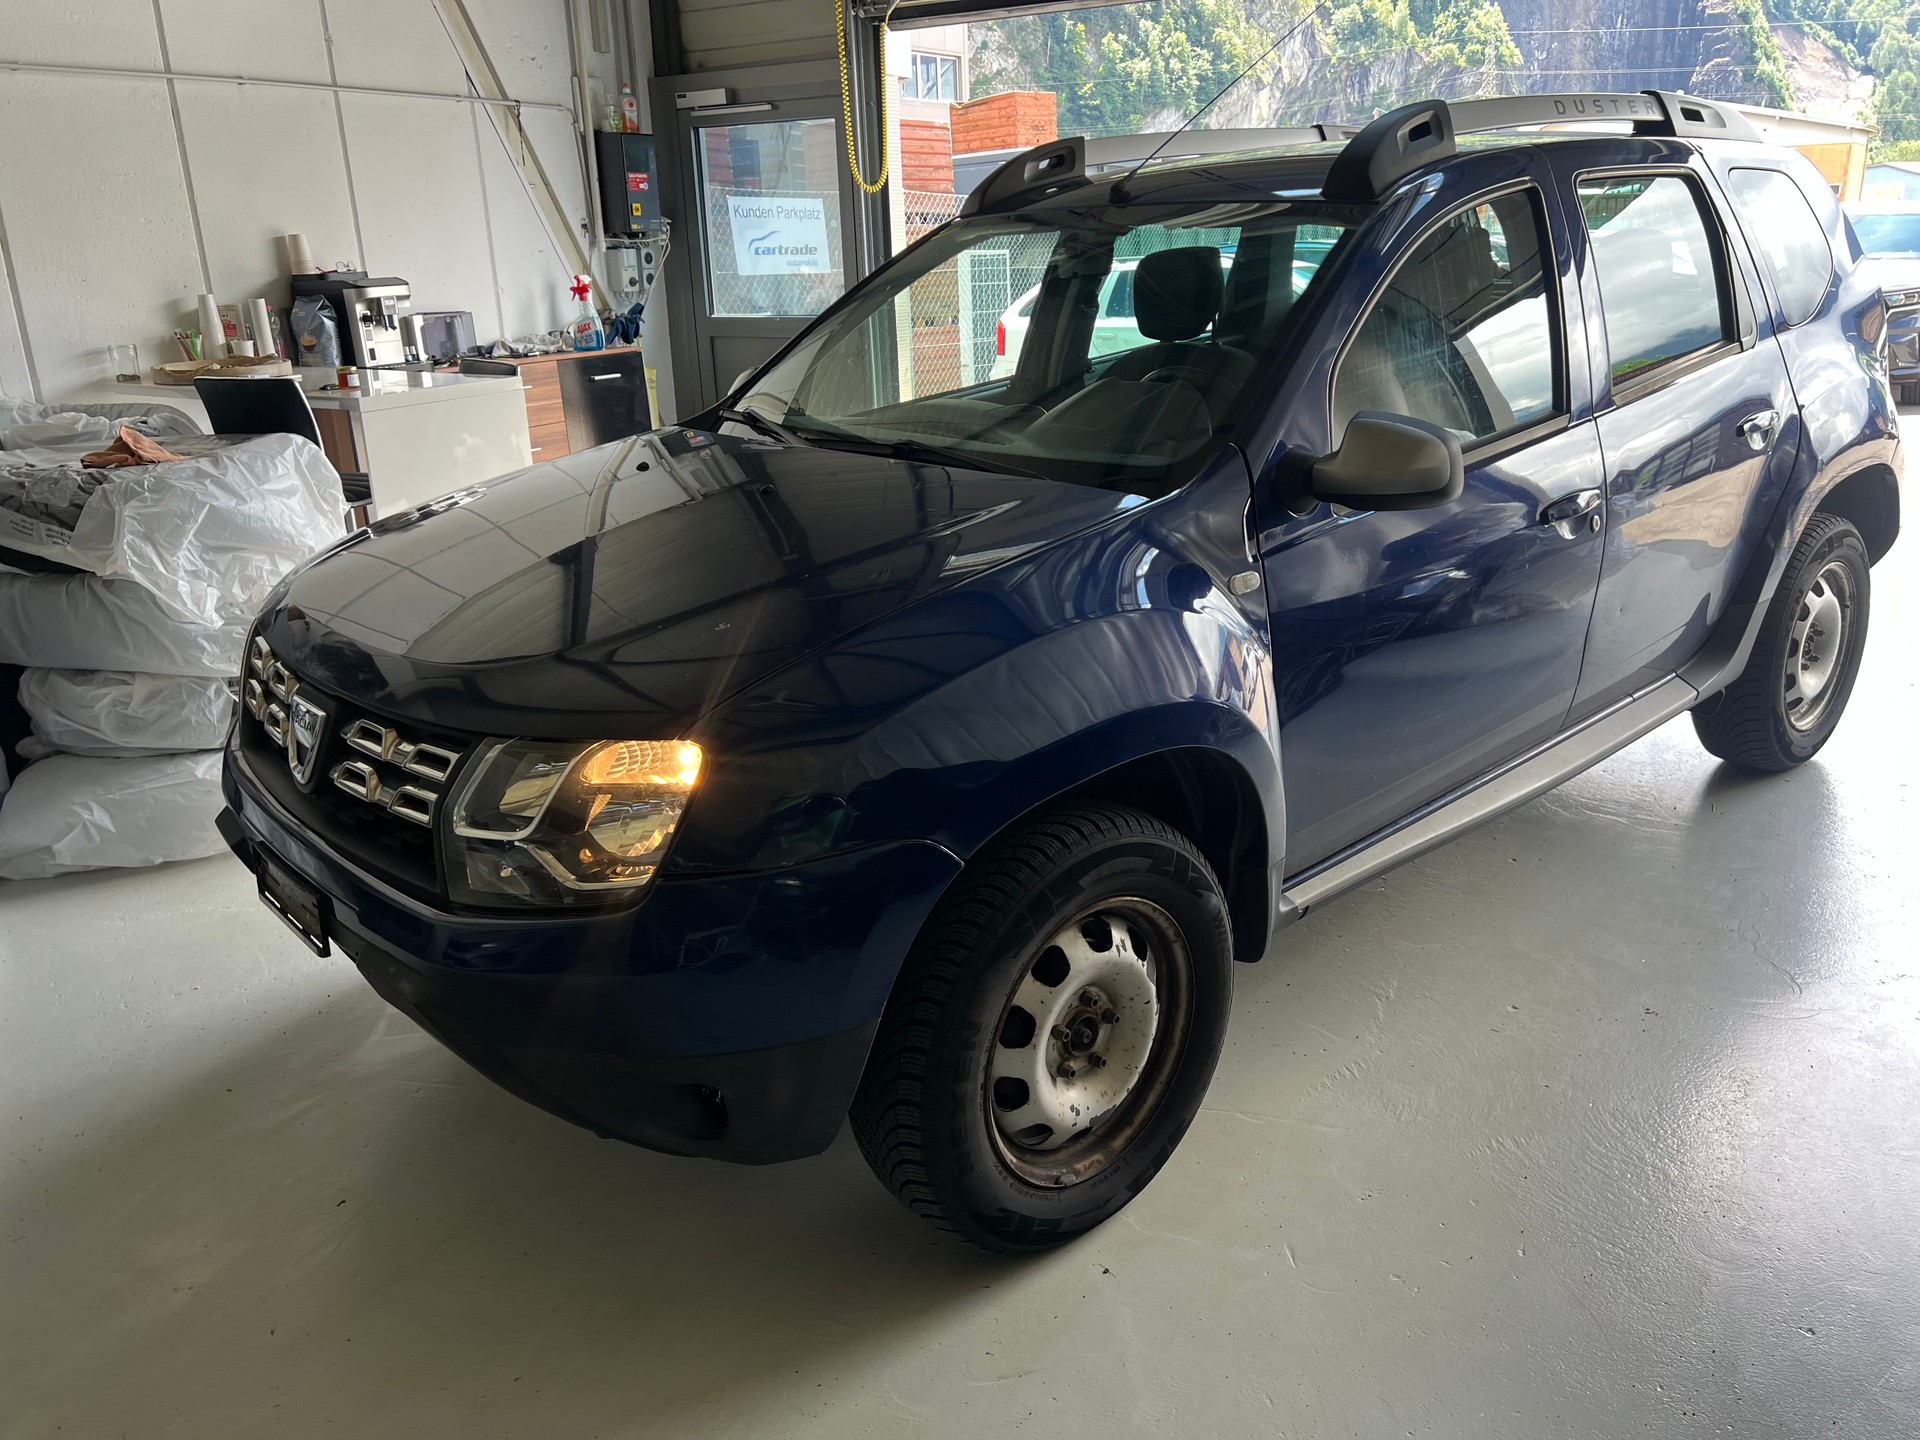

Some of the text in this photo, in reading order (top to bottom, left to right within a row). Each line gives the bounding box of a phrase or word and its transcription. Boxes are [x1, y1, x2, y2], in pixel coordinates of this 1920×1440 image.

[1553, 99, 1656, 116] DUSTER
[733, 204, 821, 222] Kunden Parkplatz
[754, 244, 818, 255] cartrade
[577, 322, 592, 334] AJAX
